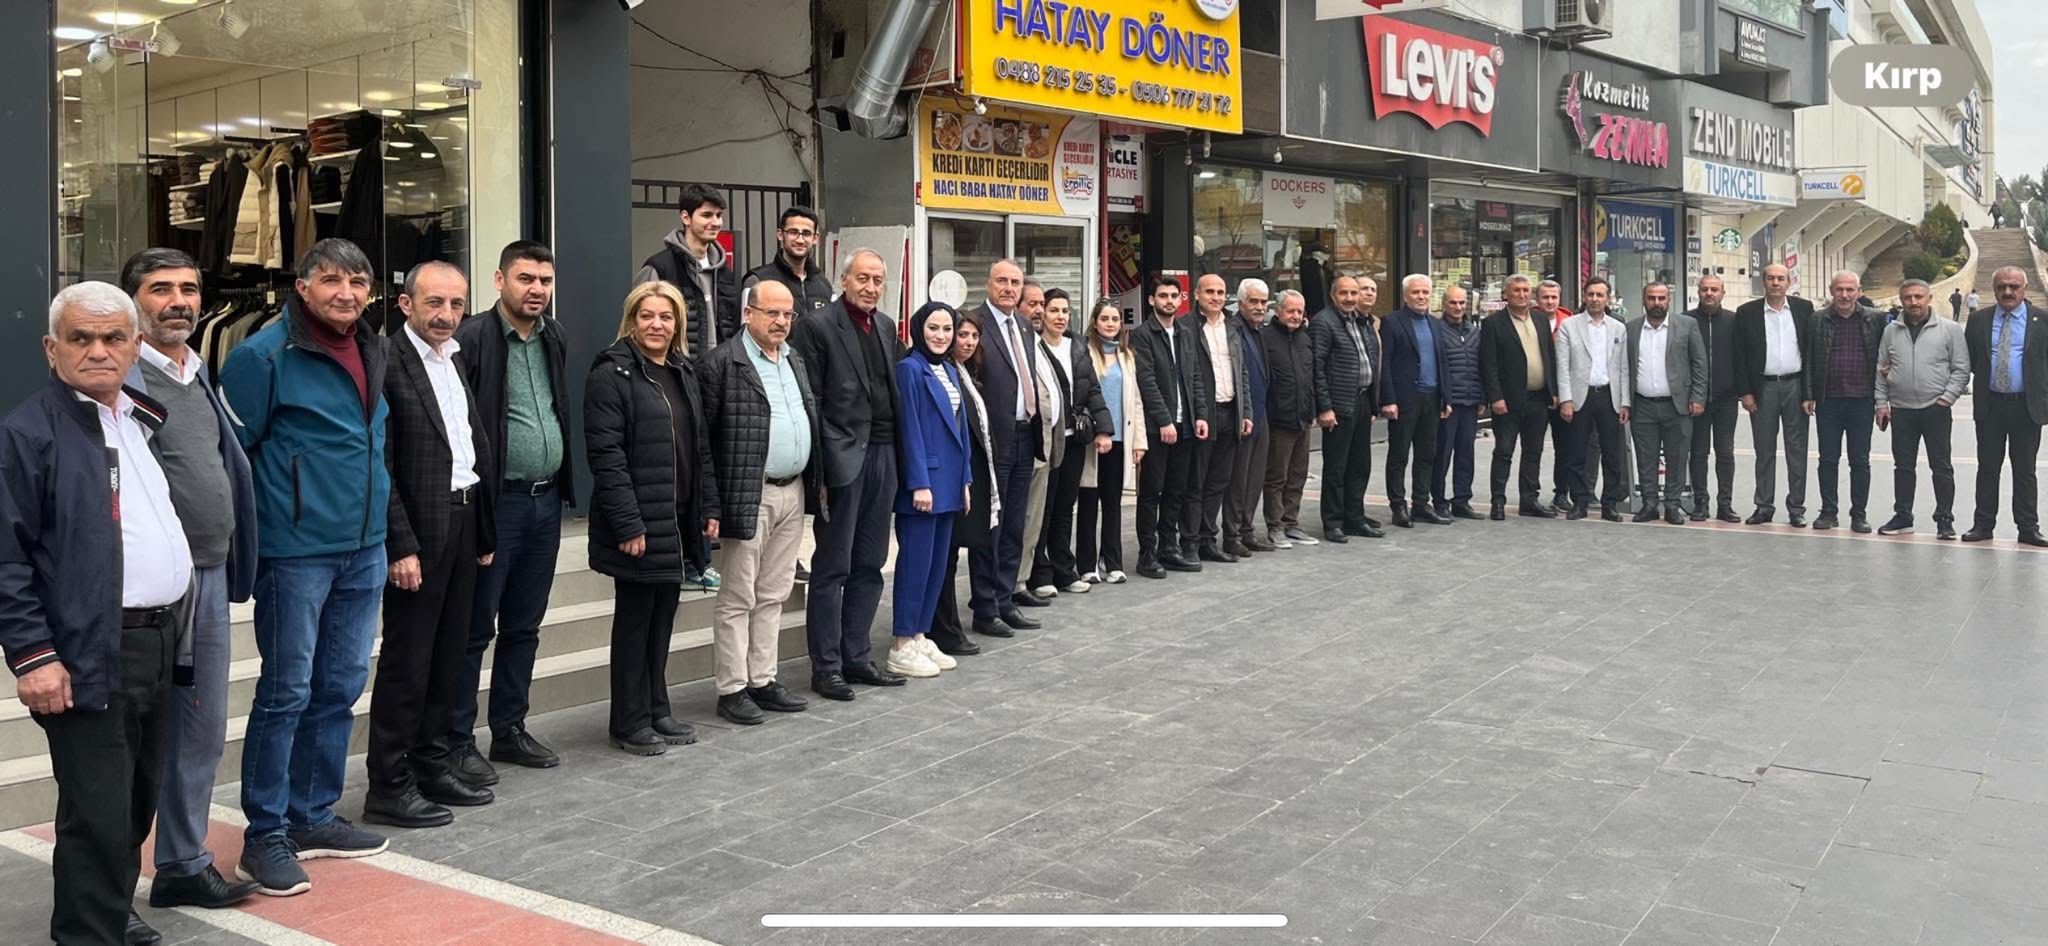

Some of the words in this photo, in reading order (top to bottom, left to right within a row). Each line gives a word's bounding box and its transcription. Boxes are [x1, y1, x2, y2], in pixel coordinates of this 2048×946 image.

[994, 0, 1111, 51] HATAY
[1121, 12, 1231, 75] DÖNER
[994, 57, 1040, 83] 0488
[1043, 65, 1071, 89] 215
[1074, 71, 1094, 92] 25
[1097, 75, 1116, 96] 35
[1171, 87, 1196, 108] 777
[1583, 70, 1650, 111] Kozmetik
[1691, 107, 1736, 157] ZEND
[964, 155, 994, 177] KARTI
[1107, 166, 1138, 181] RTASİYE
[933, 179, 958, 196] HACI
[960, 181, 988, 198] BABA
[989, 183, 1017, 200] HATAY
[1019, 184, 1049, 202] DÖNER
[1271, 178, 1326, 194] DOCKERS
[1705, 162, 1767, 201] TURKCELL
[1804, 181, 1838, 190] TURKCELL
[1609, 213, 1666, 242] TURKCELL
